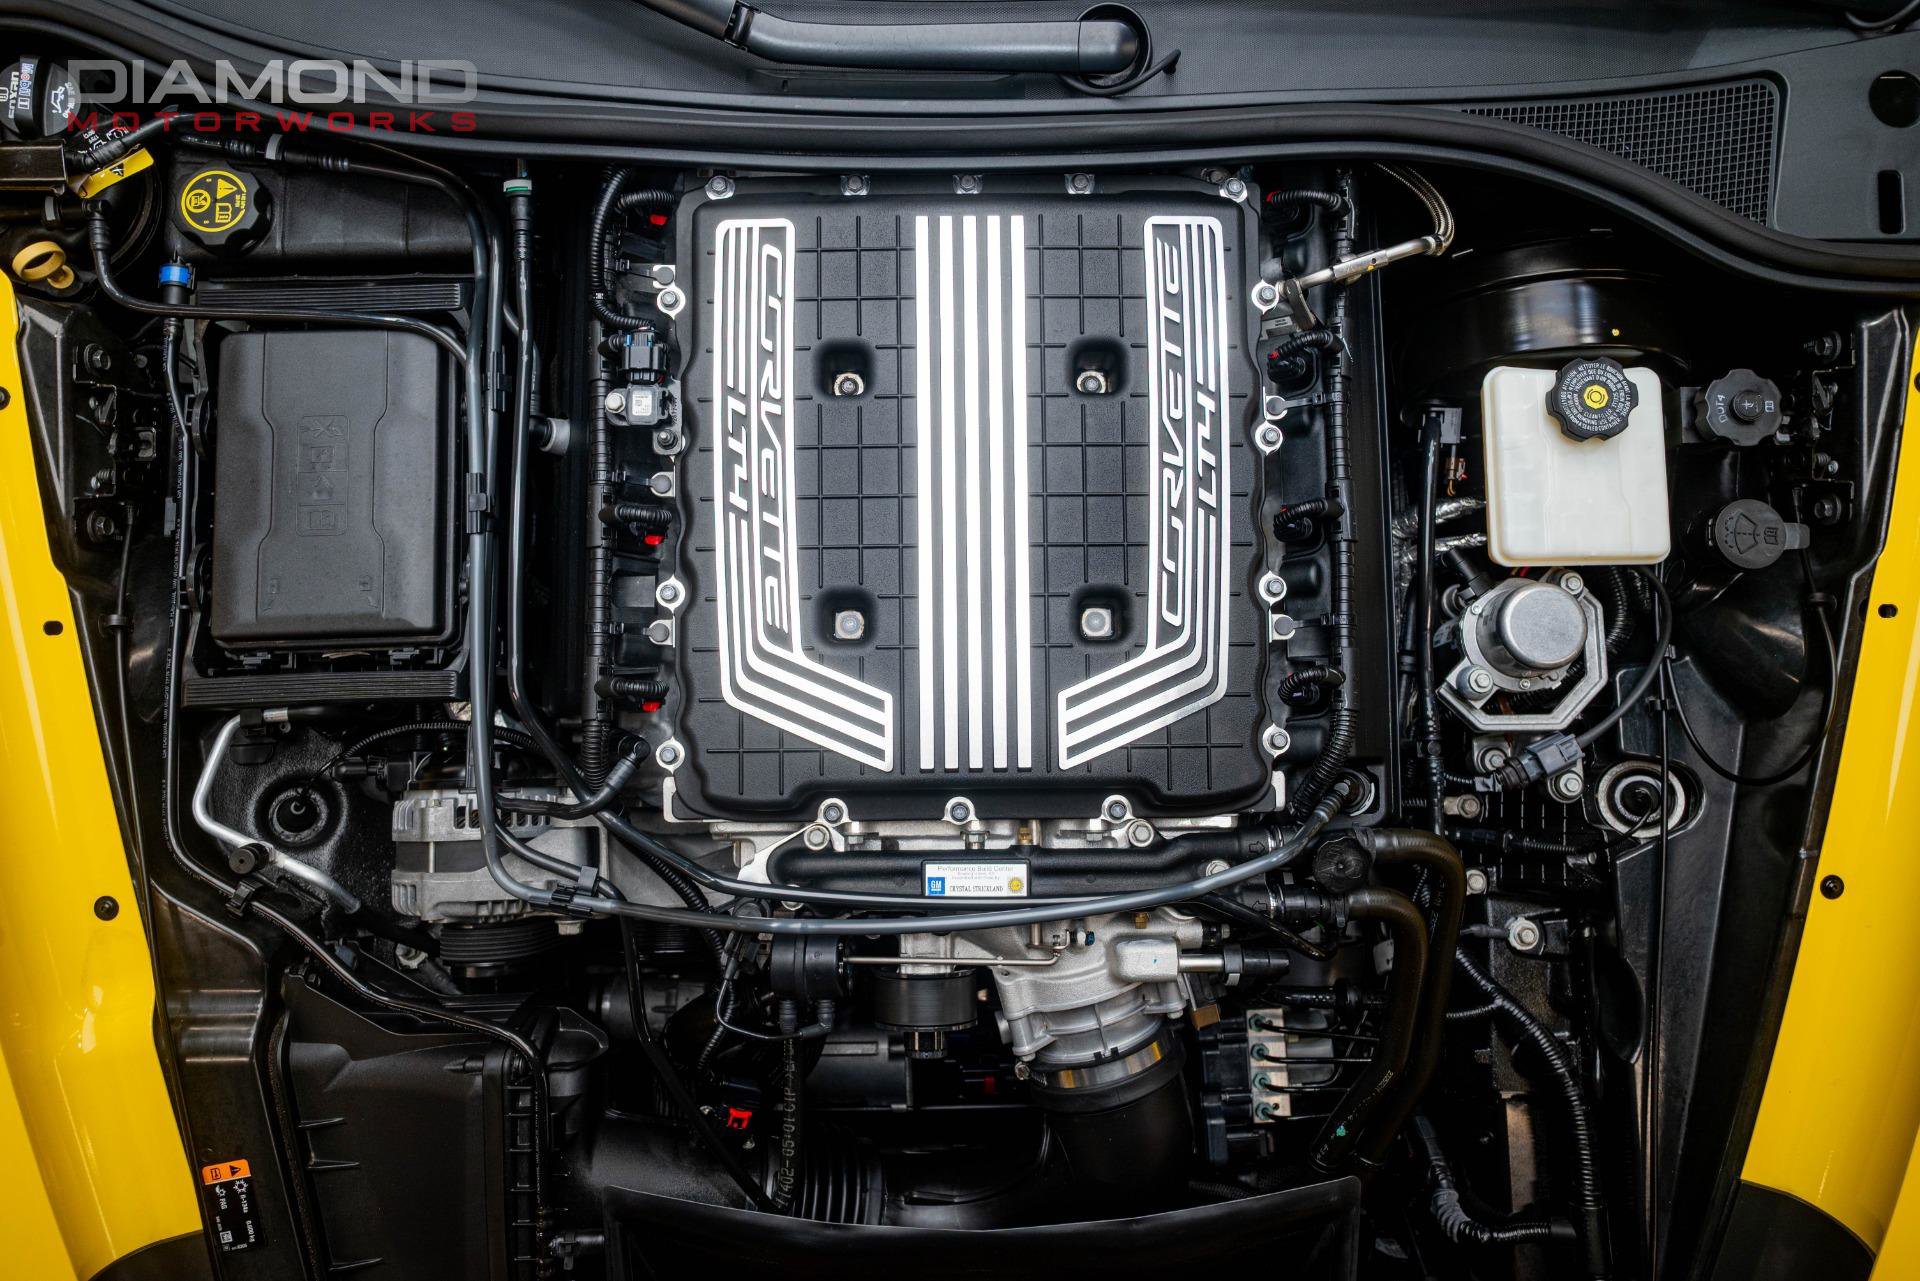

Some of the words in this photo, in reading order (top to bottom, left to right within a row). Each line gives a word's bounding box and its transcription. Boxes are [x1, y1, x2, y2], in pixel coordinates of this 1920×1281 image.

[20, 63, 34, 96] Mobil
[727, 395, 747, 512] LT4
[760, 244, 788, 634] CORVETTE
[1156, 237, 1184, 627] CORVETTE
[1197, 390, 1216, 508] LT4
[931, 880, 942, 889] GM
